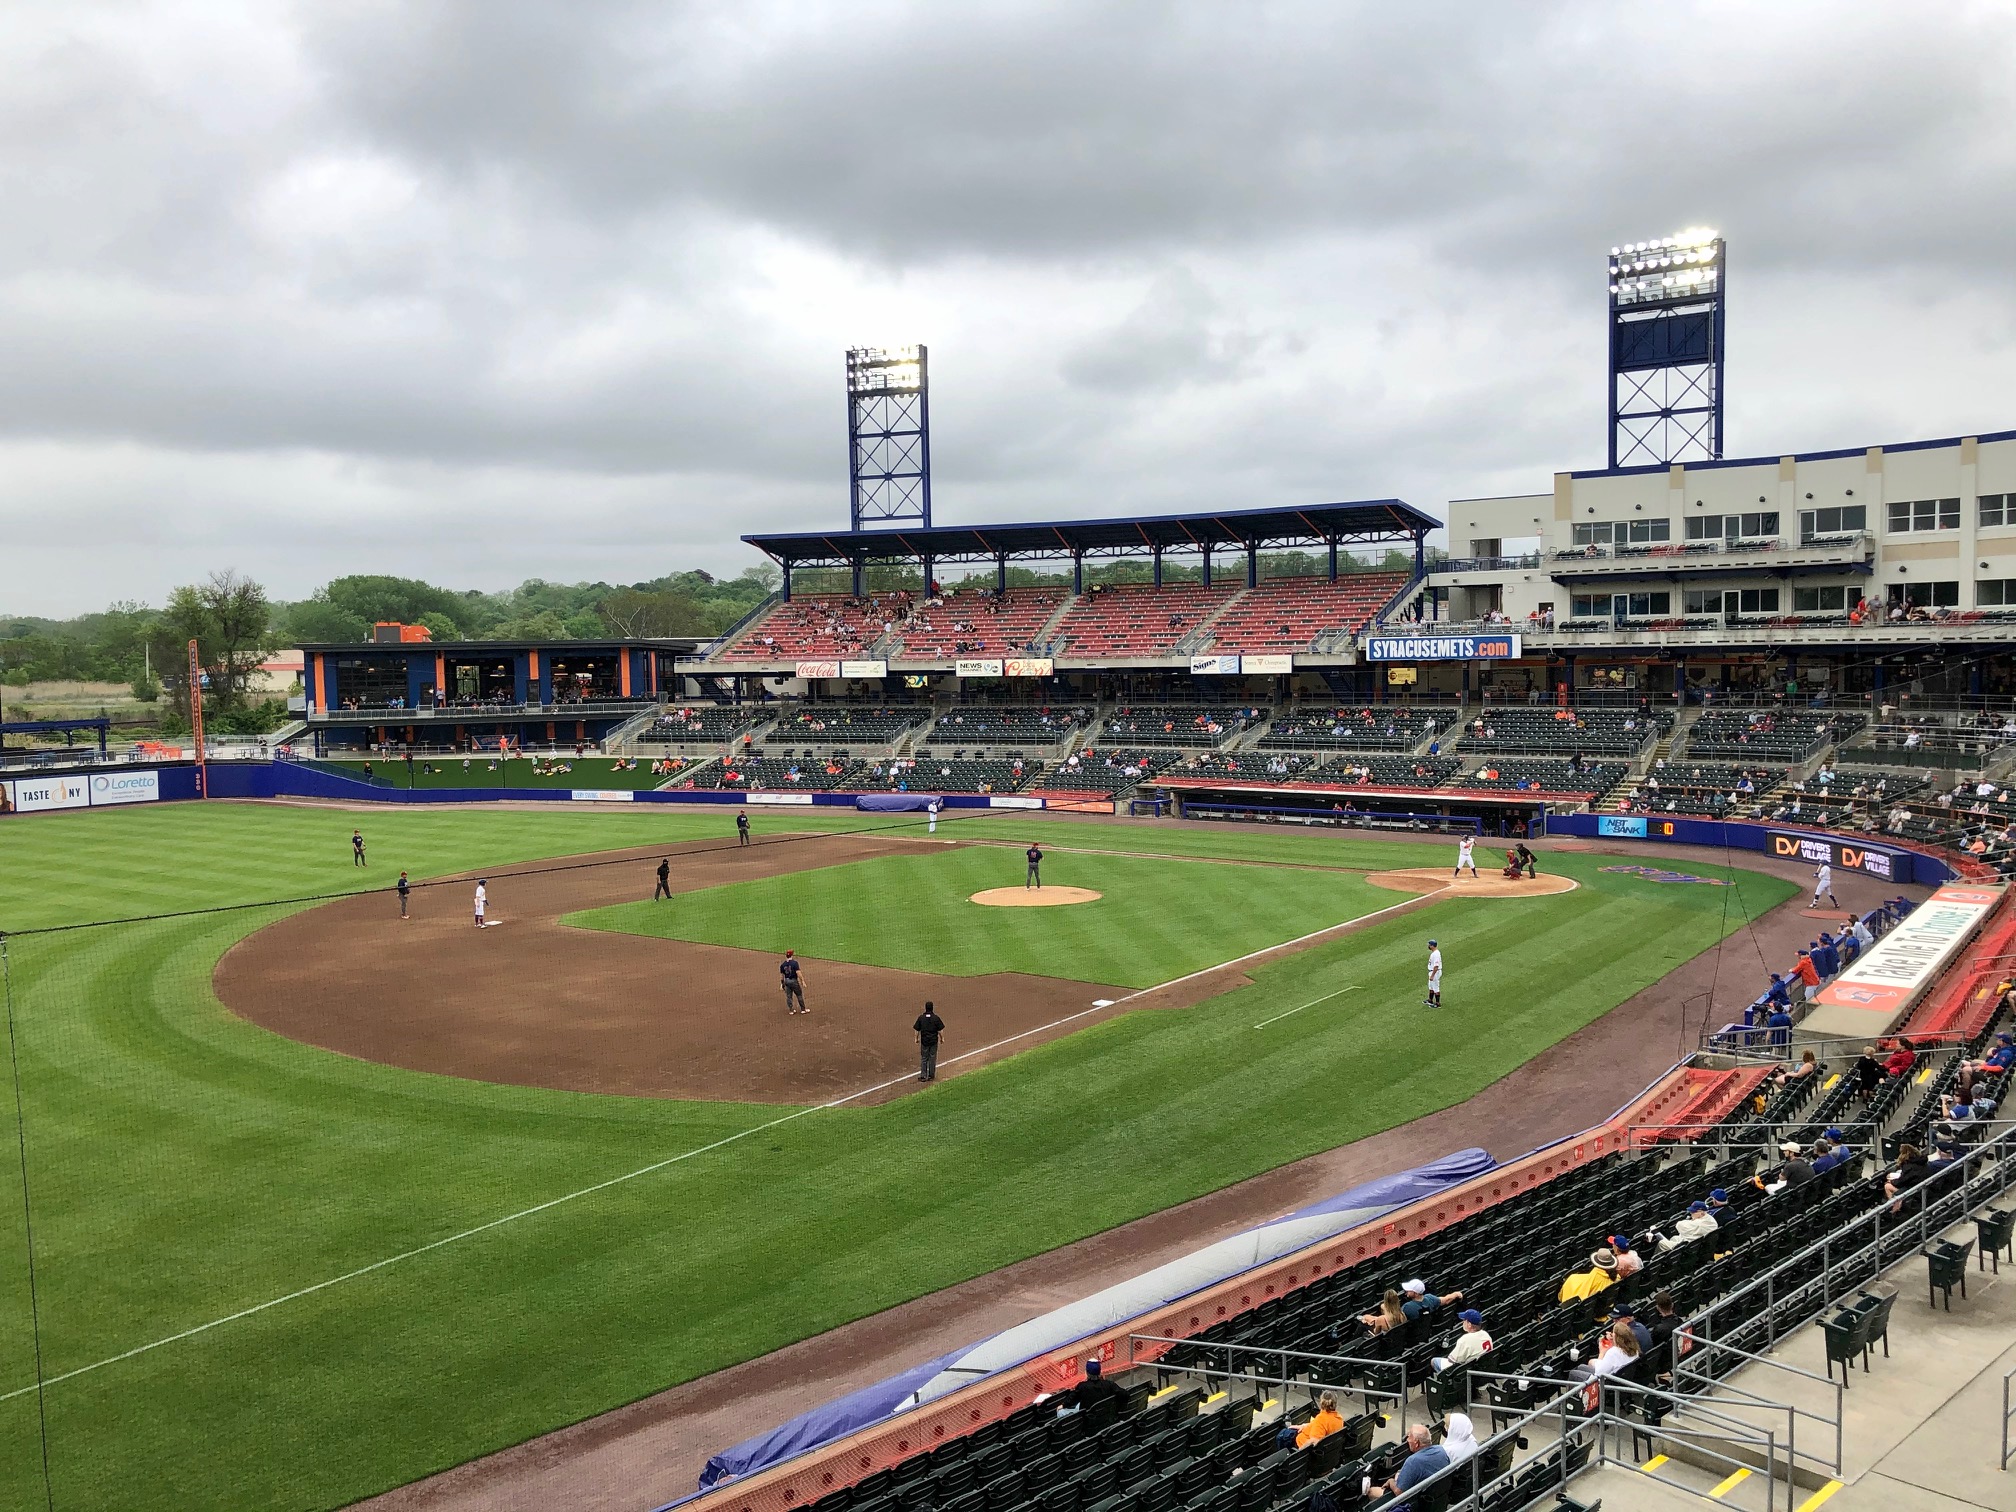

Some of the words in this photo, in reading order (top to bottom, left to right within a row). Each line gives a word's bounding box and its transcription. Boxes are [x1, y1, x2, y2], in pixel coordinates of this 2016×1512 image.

[1373, 638, 1508, 658] SYRACUSEMETS.com
[1192, 659, 1217, 672] Signs
[111, 777, 155, 790] Loretto
[23, 790, 50, 802] TASTE
[68, 788, 81, 798] NY
[1606, 819, 1628, 828] NBT
[1613, 826, 1640, 835] BANK
[1775, 837, 1800, 855] DV
[1800, 840, 1831, 853] DRIVER'S
[1801, 849, 1831, 862] VILLAGE
[1842, 848, 1865, 867] DV
[1864, 851, 1890, 865] DRIVER'S
[1865, 861, 1890, 875] VILLAGE
[1894, 935, 1950, 945] To
[1880, 945, 1941, 959] Me
[1855, 959, 1928, 980] Take
